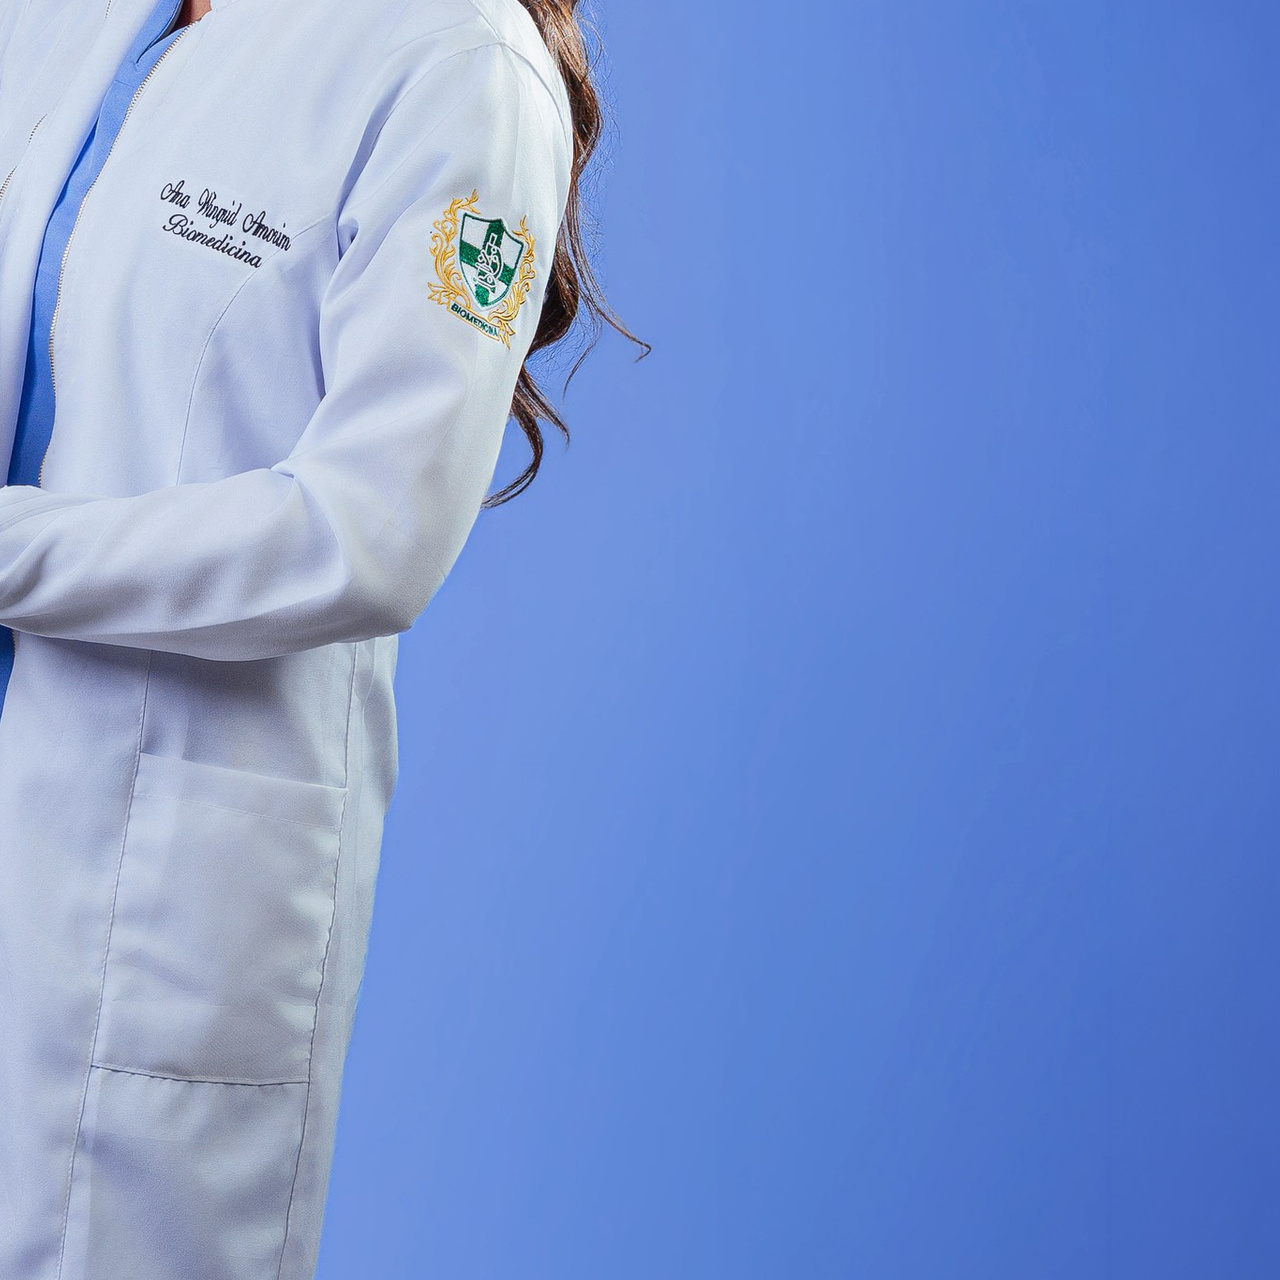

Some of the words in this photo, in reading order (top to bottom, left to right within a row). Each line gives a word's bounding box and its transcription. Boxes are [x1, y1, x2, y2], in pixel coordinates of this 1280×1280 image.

[160, 179, 191, 209] Ana
[241, 210, 292, 252] Amorim
[162, 213, 262, 269] Biomedicina
